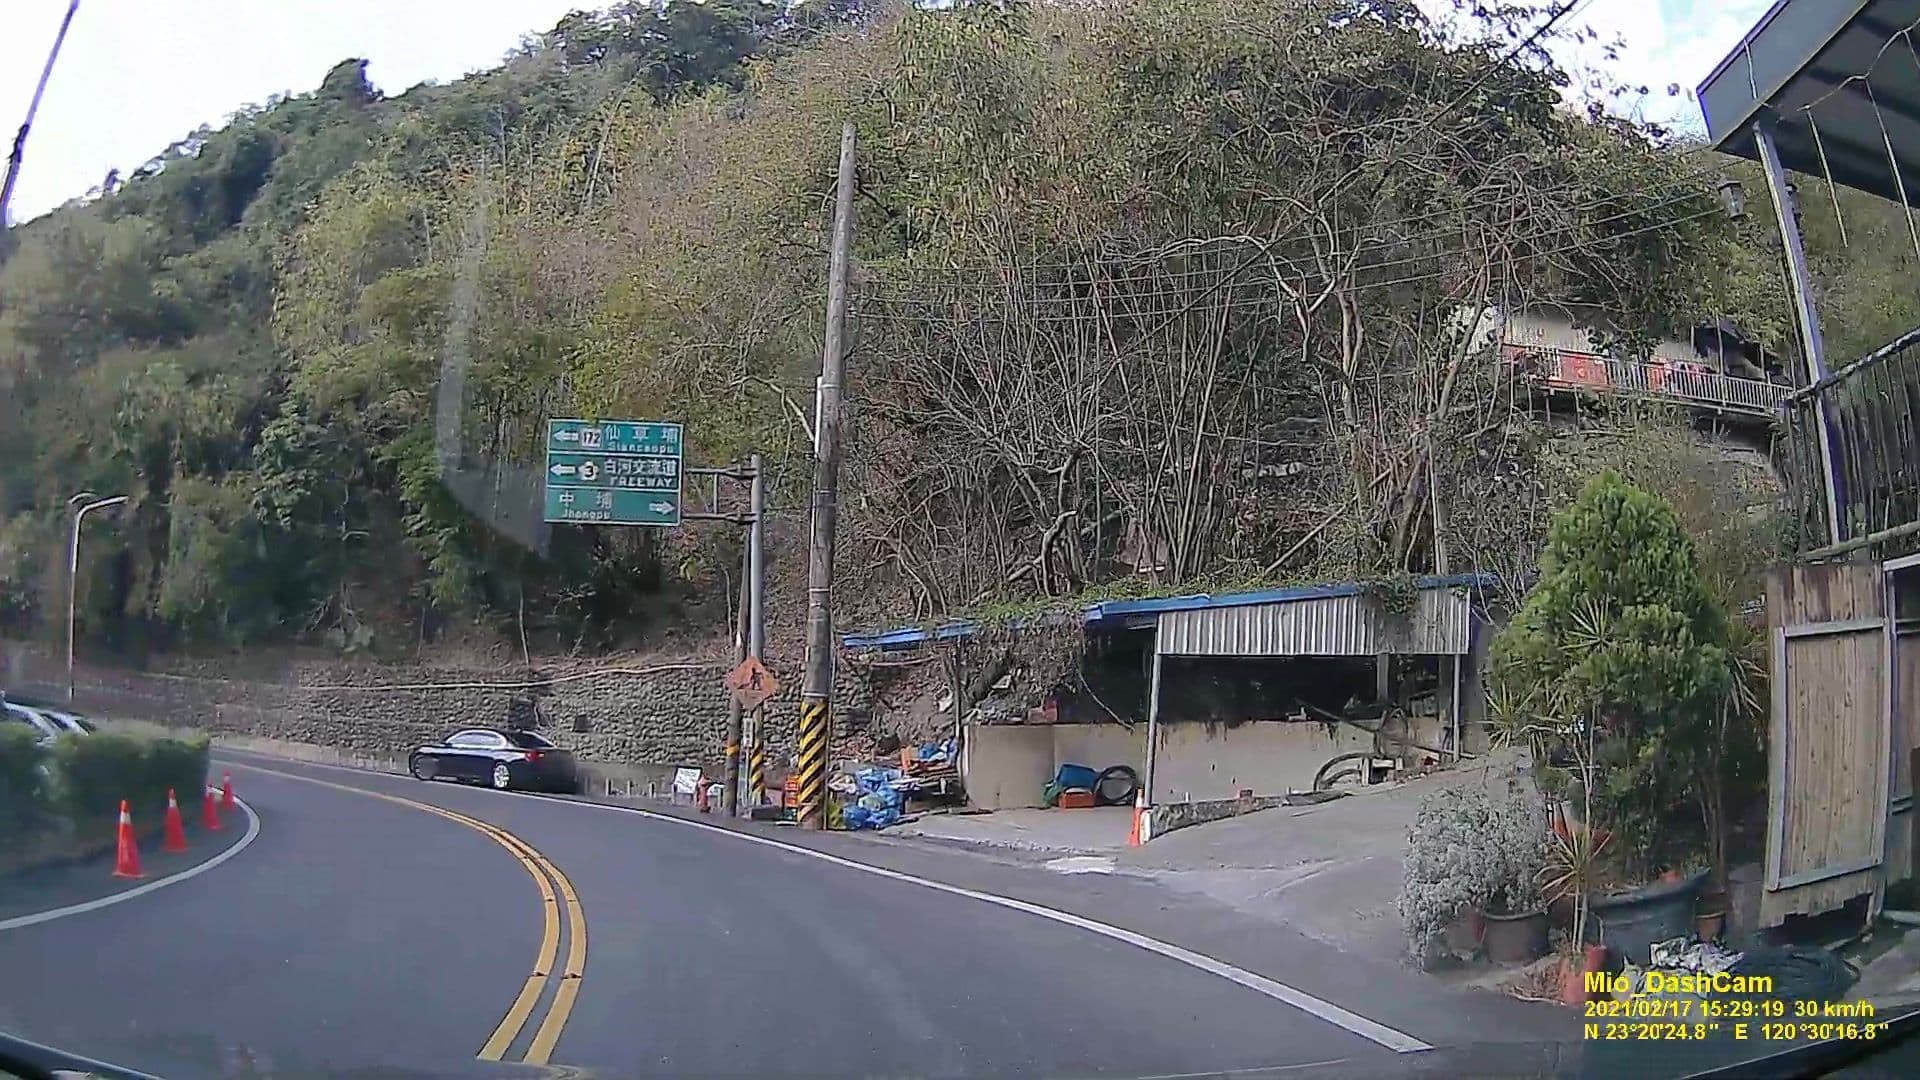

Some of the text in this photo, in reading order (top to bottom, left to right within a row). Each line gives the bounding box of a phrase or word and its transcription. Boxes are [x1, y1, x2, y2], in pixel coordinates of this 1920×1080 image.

[582, 431, 601, 444] 172
[583, 465, 595, 478] 3
[604, 458, 677, 476] 白河交流道
[559, 489, 613, 510] 中埔
